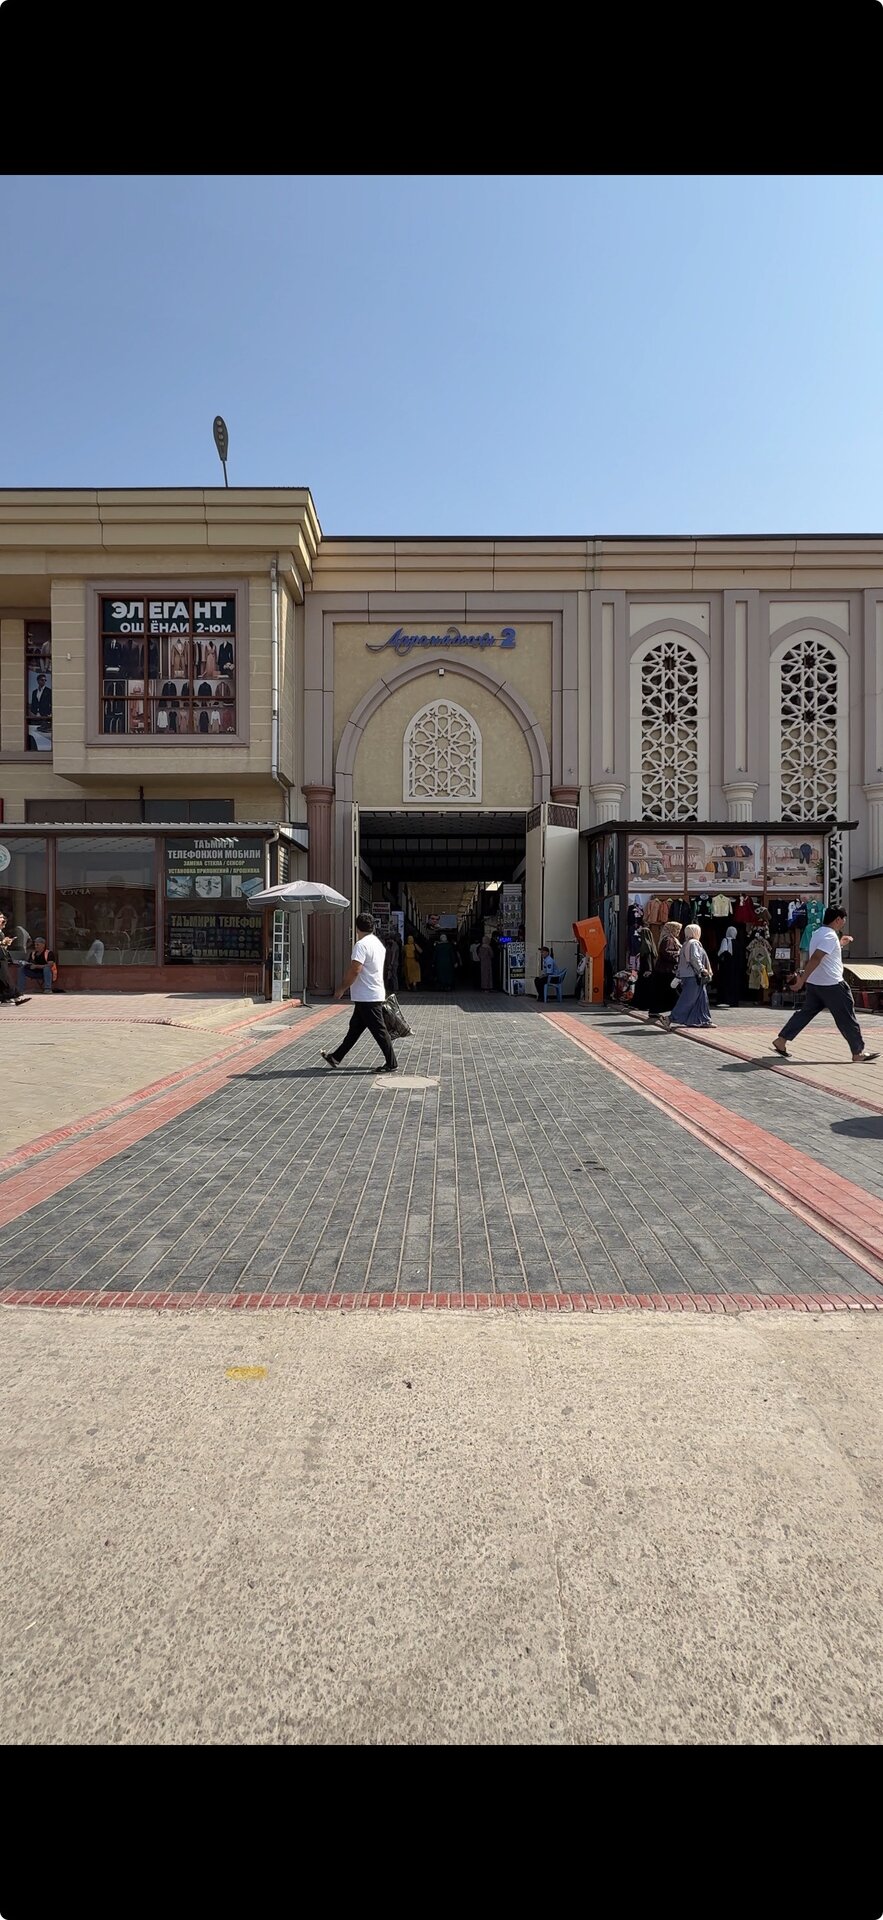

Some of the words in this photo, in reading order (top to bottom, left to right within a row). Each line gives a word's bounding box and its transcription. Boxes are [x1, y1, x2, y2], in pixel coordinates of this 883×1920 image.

[111, 601, 227, 619] ЭЛЕГАНТ
[120, 620, 190, 633] ОШЁНАИ
[196, 623, 231, 633] 2-юм
[500, 627, 516, 649] 2
[193, 839, 235, 849] ТАЪМИРИ
[171, 915, 216, 927] ТАЪМИРИ
[219, 916, 262, 928] ТЕЛЕФОН
